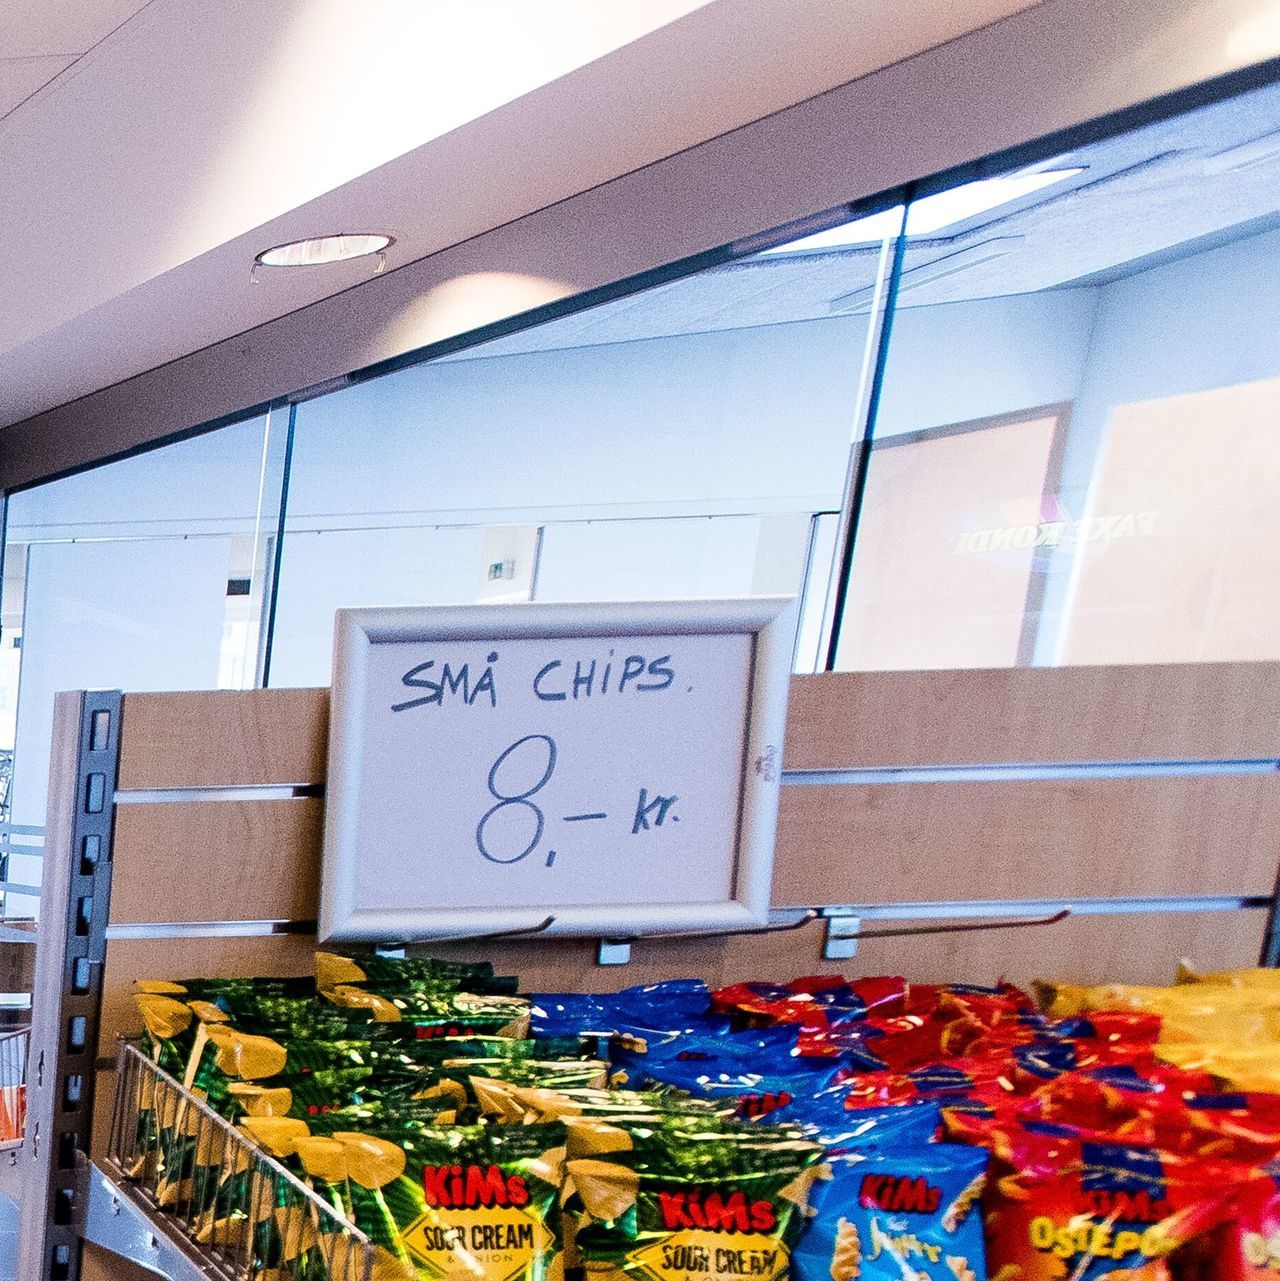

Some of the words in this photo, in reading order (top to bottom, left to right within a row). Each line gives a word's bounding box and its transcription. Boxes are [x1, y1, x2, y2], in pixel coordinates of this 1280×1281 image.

[391, 651, 499, 712] SMÅ
[471, 1224, 534, 1250] CREAM
[661, 1244, 713, 1272] SOUR
[716, 1248, 778, 1276] CREAM
